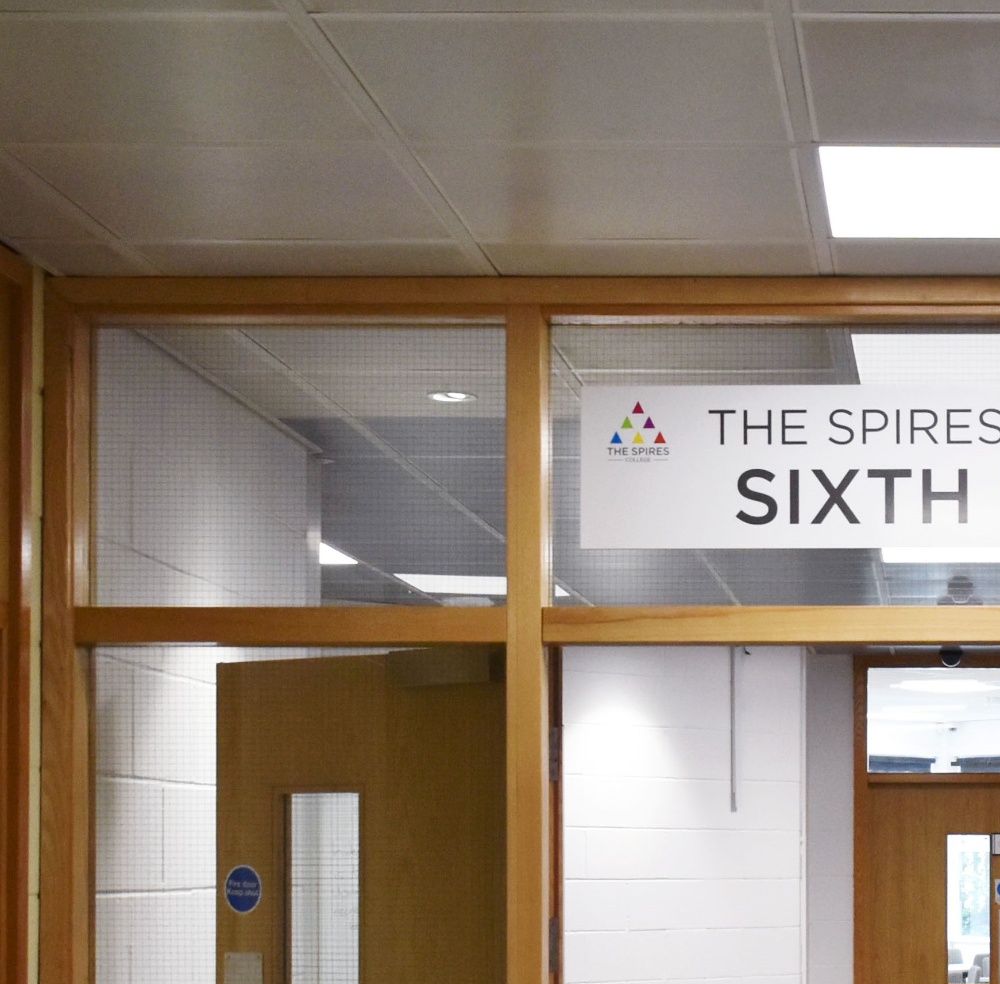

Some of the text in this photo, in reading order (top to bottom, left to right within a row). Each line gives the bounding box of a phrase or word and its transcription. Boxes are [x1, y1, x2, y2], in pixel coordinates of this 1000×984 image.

[707, 409, 808, 446] THE
[607, 446, 670, 456] THE SPIRES
[735, 468, 968, 526] SIXTH
